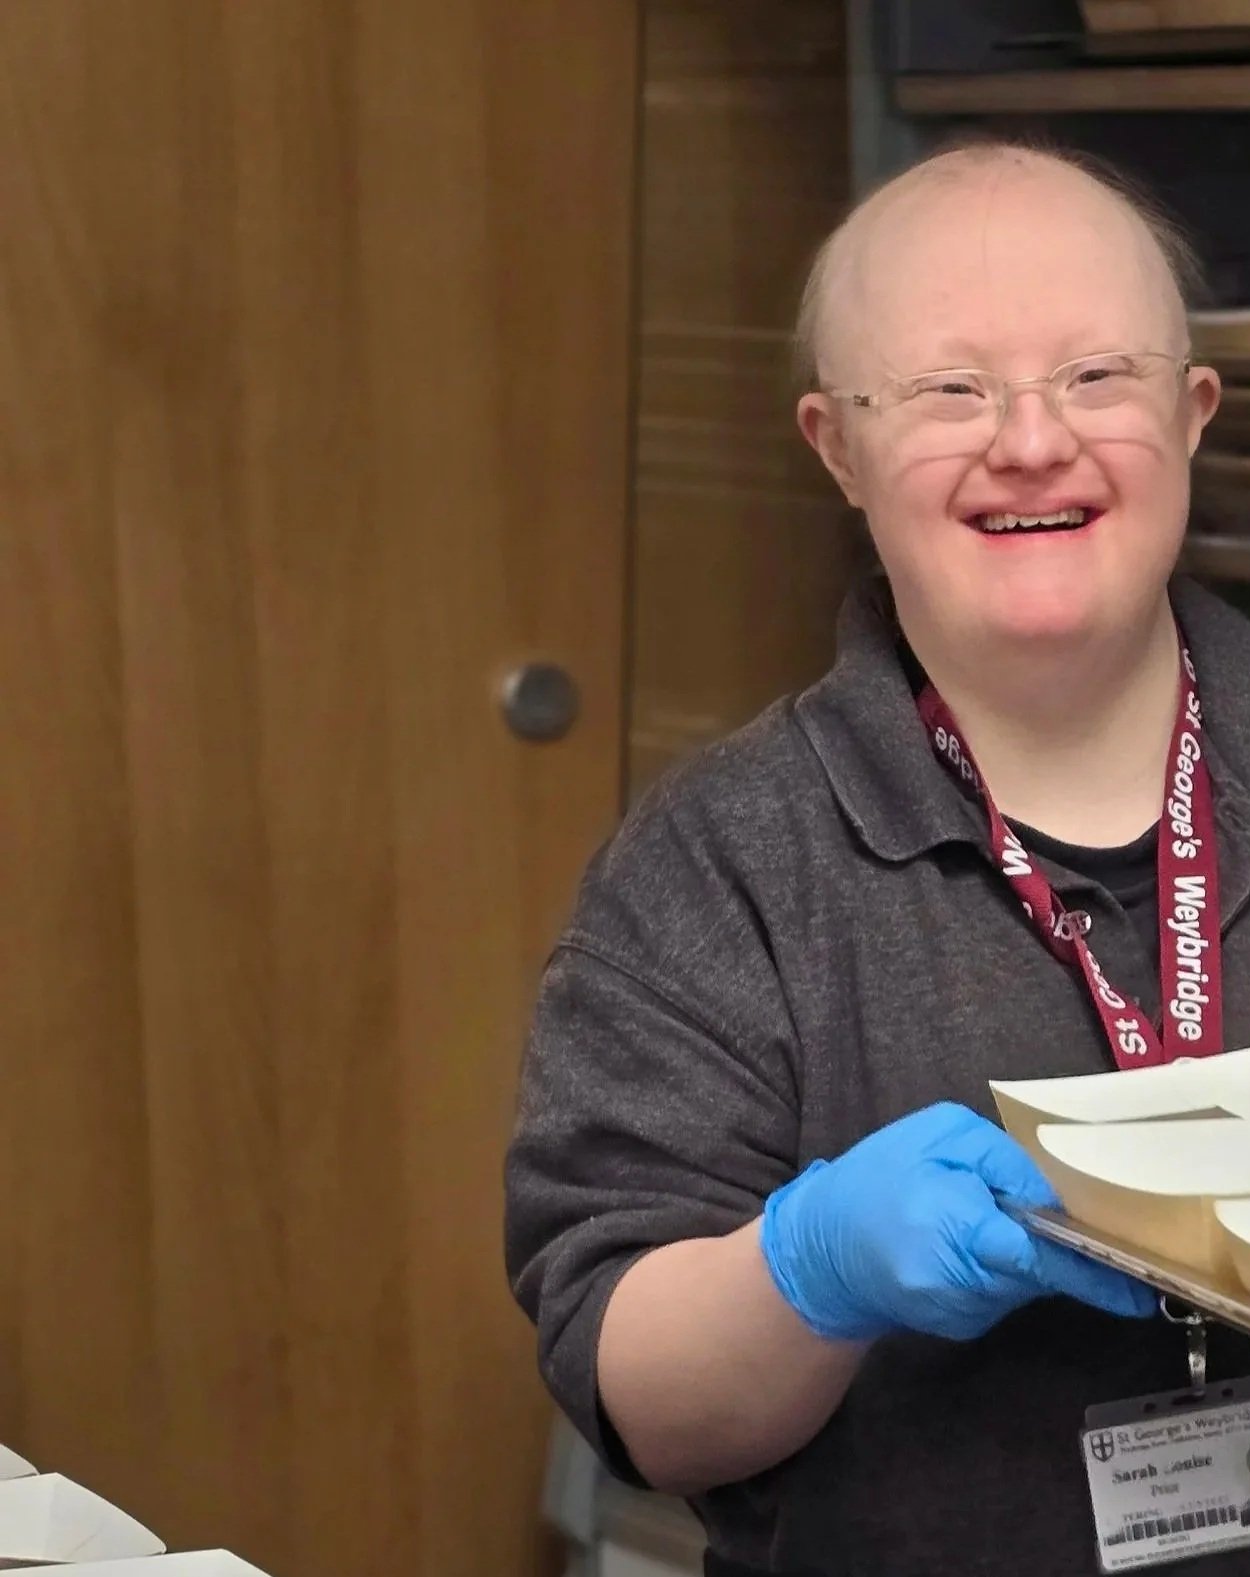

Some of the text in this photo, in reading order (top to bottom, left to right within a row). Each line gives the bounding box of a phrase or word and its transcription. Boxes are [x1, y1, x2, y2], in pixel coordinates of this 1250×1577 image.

[1185, 692, 1201, 730] St
[1167, 732, 1202, 861] George's
[1167, 876, 1210, 1042] Weybridge
[1118, 1018, 1148, 1057] St
[1112, 1464, 1158, 1484] Sarah
